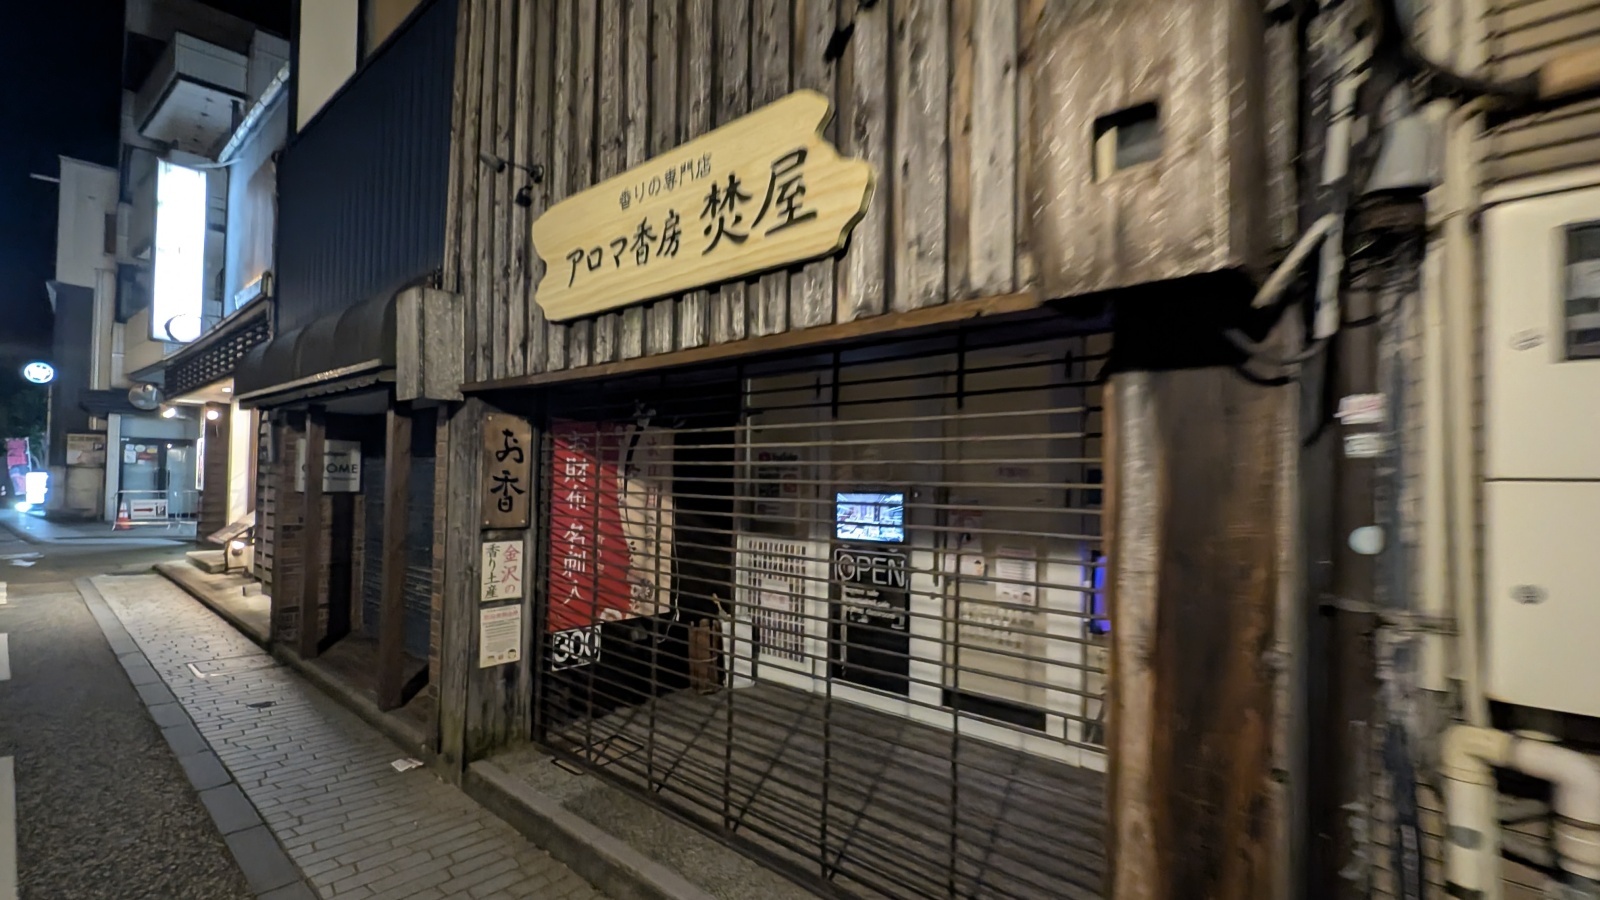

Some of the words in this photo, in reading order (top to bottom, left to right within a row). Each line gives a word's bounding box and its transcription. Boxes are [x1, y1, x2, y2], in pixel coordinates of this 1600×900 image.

[619, 152, 712, 211] 香りの専門店
[566, 209, 682, 288] アロマ香房
[700, 147, 817, 256] 焚屋
[490, 428, 525, 513] お香
[484, 543, 501, 599] 香り土産
[501, 544, 521, 595] 金沢の
[838, 554, 904, 587] OPEN
[553, 629, 599, 663] 300
